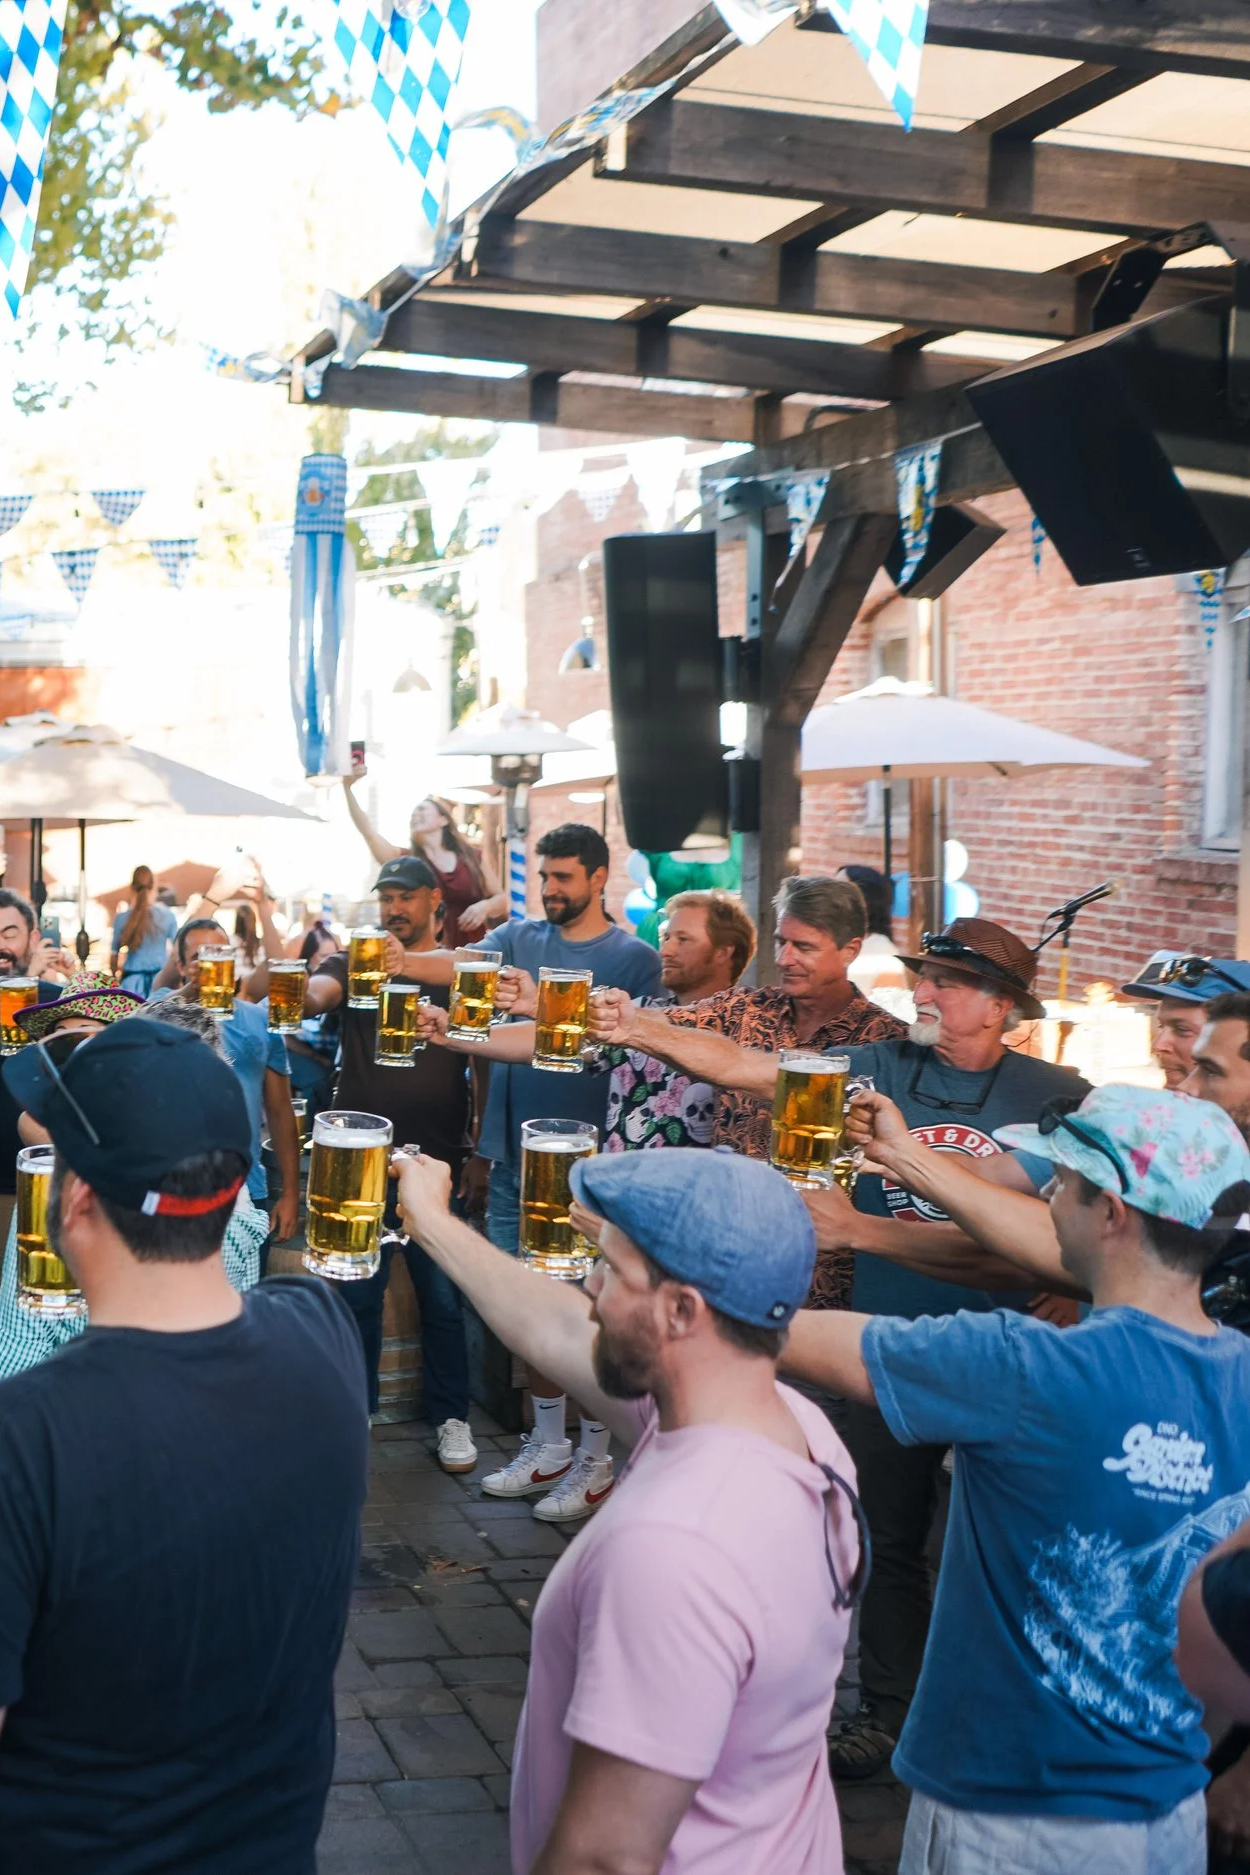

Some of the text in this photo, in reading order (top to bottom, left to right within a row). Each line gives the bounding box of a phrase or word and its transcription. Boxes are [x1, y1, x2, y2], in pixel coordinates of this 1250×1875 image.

[943, 1128, 958, 1142] &
[963, 1133, 996, 1157] DR
[886, 1191, 907, 1200] BEER
[886, 1198, 909, 1208] SHOP
